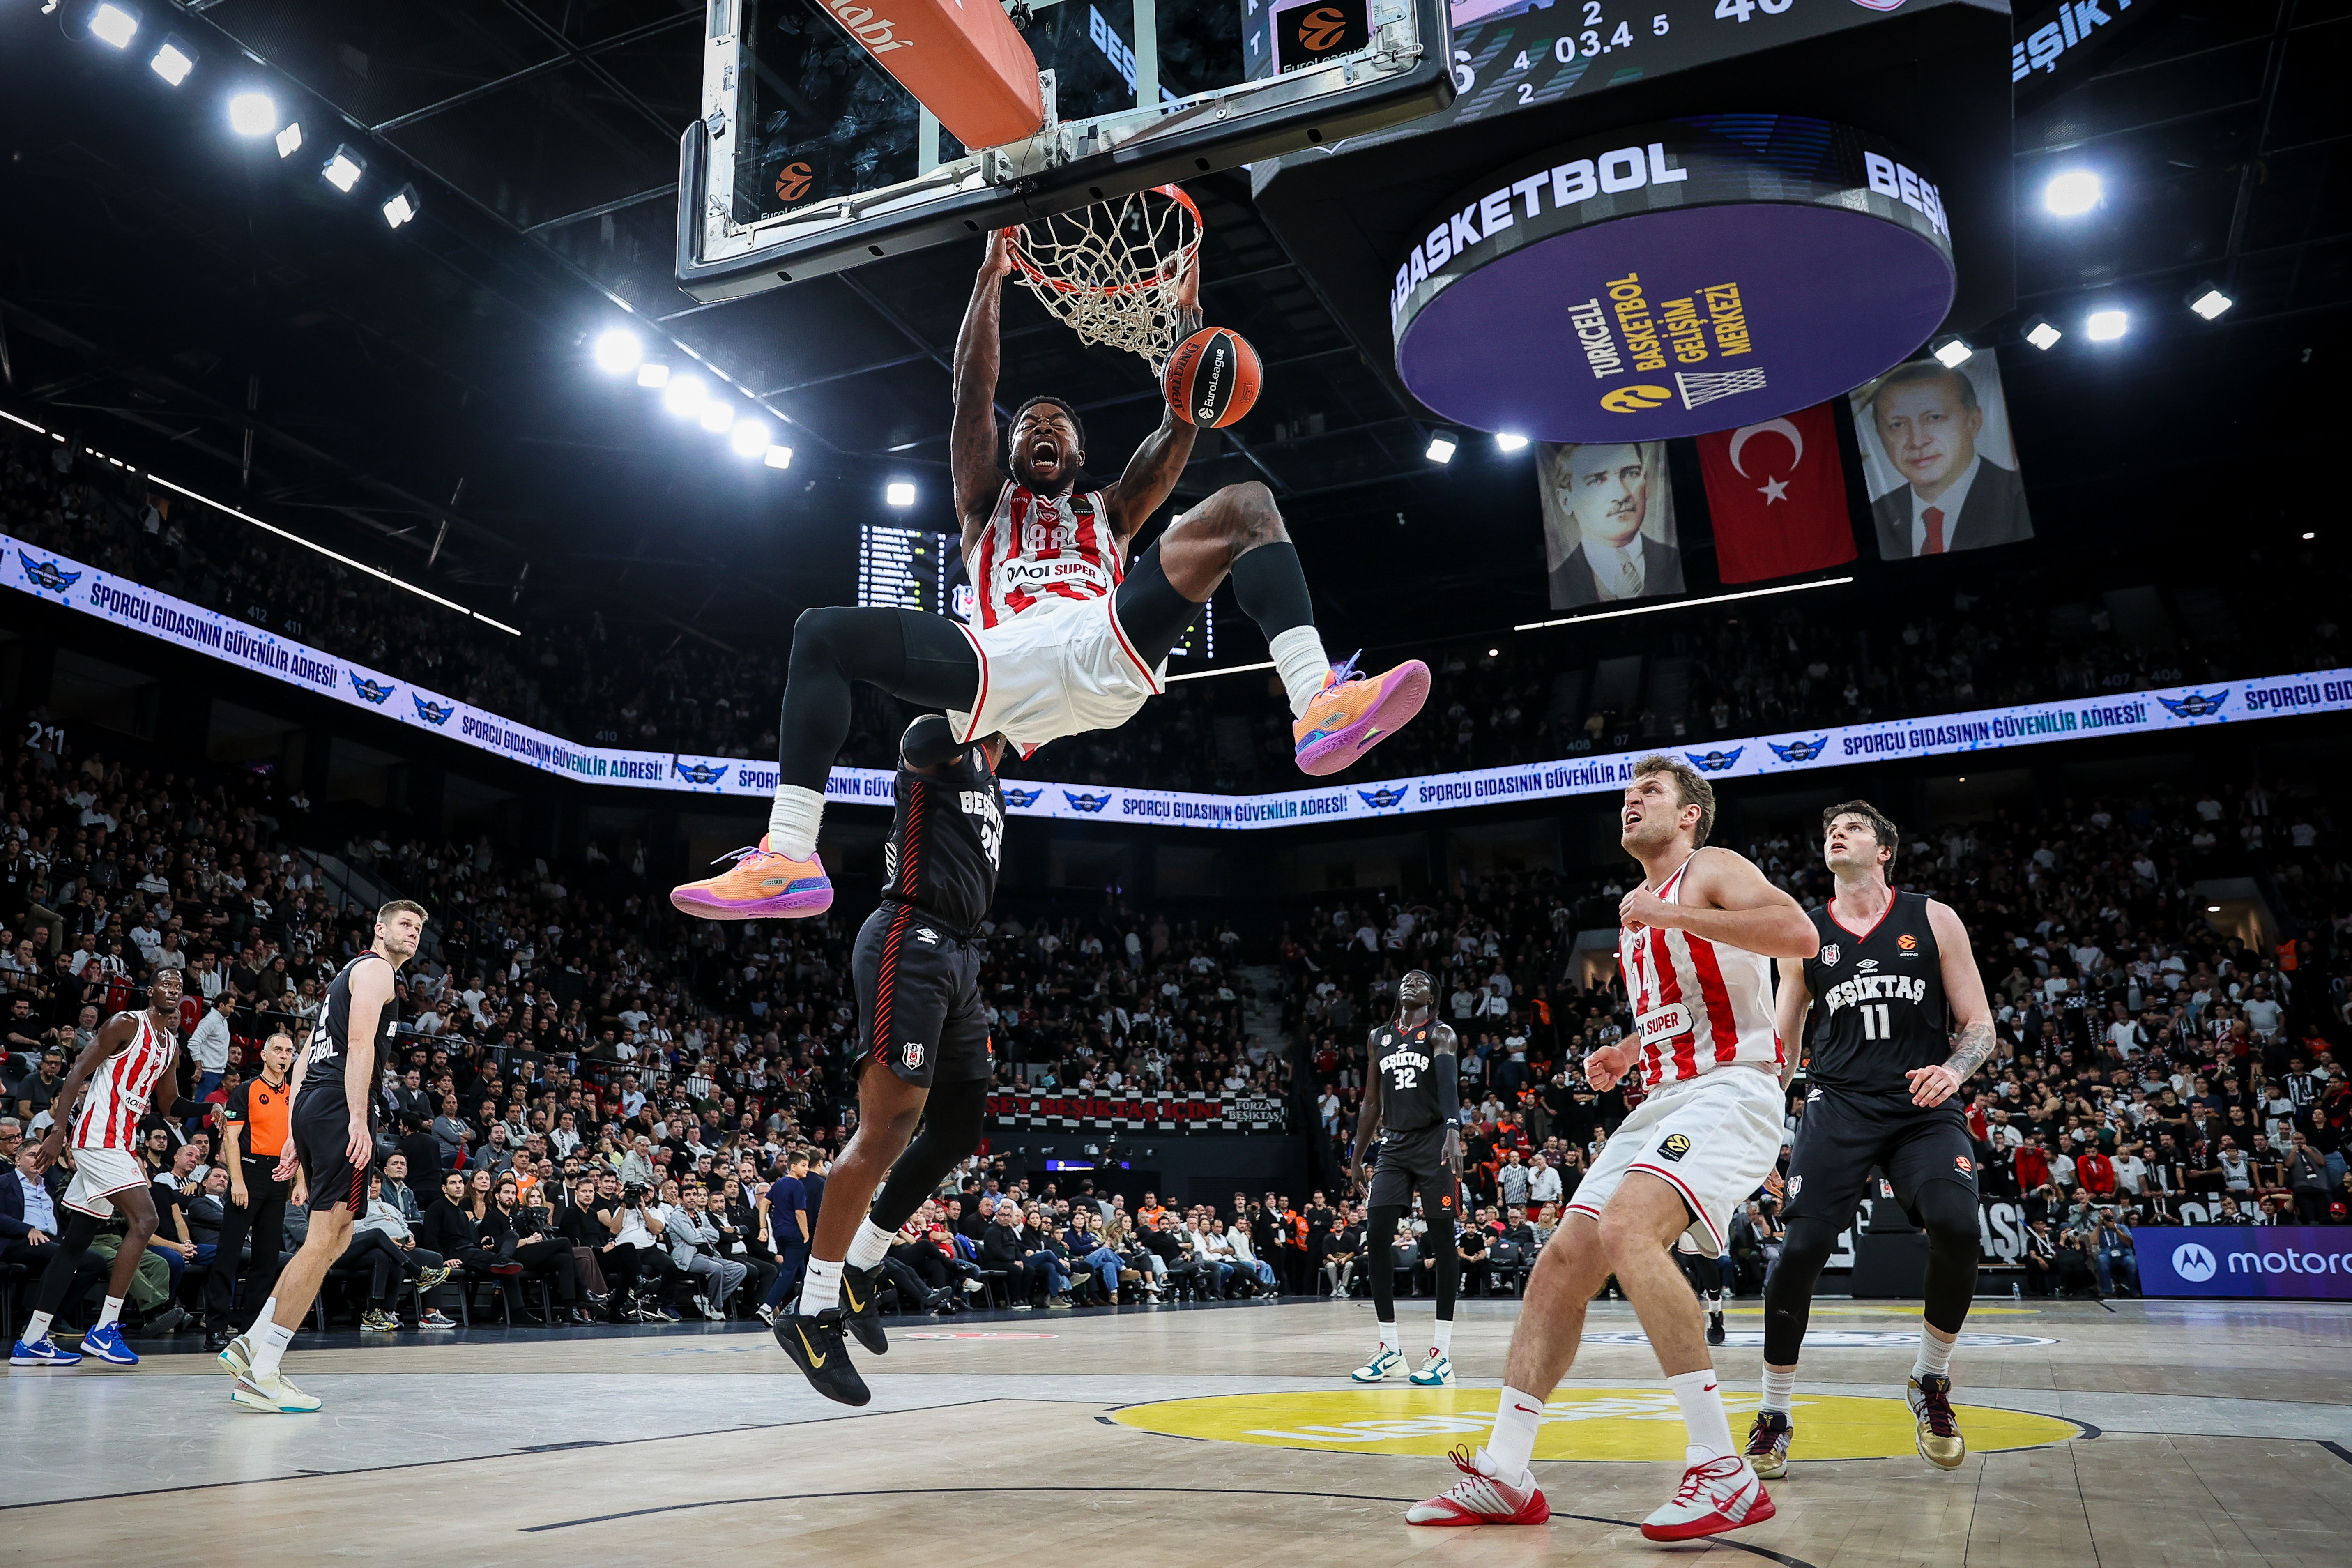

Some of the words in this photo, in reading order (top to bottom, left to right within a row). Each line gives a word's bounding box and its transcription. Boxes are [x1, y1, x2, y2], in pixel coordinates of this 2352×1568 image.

[1583, 1, 1603, 26] 2
[1652, 14, 1670, 36] 5
[1514, 50, 1530, 70] 4
[1517, 83, 1535, 105] 2
[1396, 142, 1688, 313] BASKETBOL
[1606, 272, 1667, 372] BASKETBOL
[1657, 297, 1709, 364] GELİŞİM
[1694, 282, 1752, 357] MERKEZİ
[1567, 297, 1624, 379] TURKCELL
[1204, 349, 1225, 407] EuroLeague
[1029, 524, 1069, 551] 88
[1054, 564, 1096, 580] SUPER
[247, 605, 267, 623] 412
[284, 619, 302, 636] 411
[90, 582, 150, 624] SPORCU
[152, 603, 221, 648] GIDASININ
[223, 626, 289, 672] GÜVENİLİR
[290, 654, 338, 689] ADRESİ!
[2244, 682, 2321, 711] SPORCU
[25, 721, 65, 755] 211
[595, 730, 618, 742] 410
[1613, 733, 1629, 747] 07
[1843, 730, 1906, 755] SPORCU
[1908, 721, 1990, 748] GIDASININ
[1993, 707, 2078, 739] GÜVENİLİR
[2081, 701, 2147, 730] ADRESİ!
[462, 715, 502, 746] SPORCU
[503, 730, 552, 763] GIDASININ
[552, 745, 607, 777] GÜVENİLİR
[610, 759, 663, 781] ADRESİ!
[1419, 781, 1472, 804] SPORCU
[1475, 772, 1542, 797] GIDASININ
[1545, 763, 1615, 790] GÜVENİLİR
[1123, 798, 1170, 817] SPORCU
[1173, 800, 1232, 822] GIDASININ
[1234, 798, 1298, 822] GÜVENİLİR
[1300, 792, 1348, 817] ADRESİ!
[917, 935, 936, 945] umbro
[1631, 956, 1653, 999] 14
[1825, 974, 1926, 1017] BEŞİKTAŞ
[1647, 1012, 1679, 1036] SUPER
[1860, 1004, 1891, 1041] 11
[1379, 1050, 1430, 1075] BEŞİKTAŞ
[138, 1068, 156, 1093] 24
[1393, 1067, 1417, 1091] 32
[1039, 1096, 1158, 1122] BEŞİKTAŞ
[1162, 1099, 1222, 1123] İÇİN!
[1229, 1110, 1280, 1123] BEŞİKTAŞ
[1235, 1101, 1271, 1110] FORZA
[1659, 1149, 1679, 1161] ETIHAD
